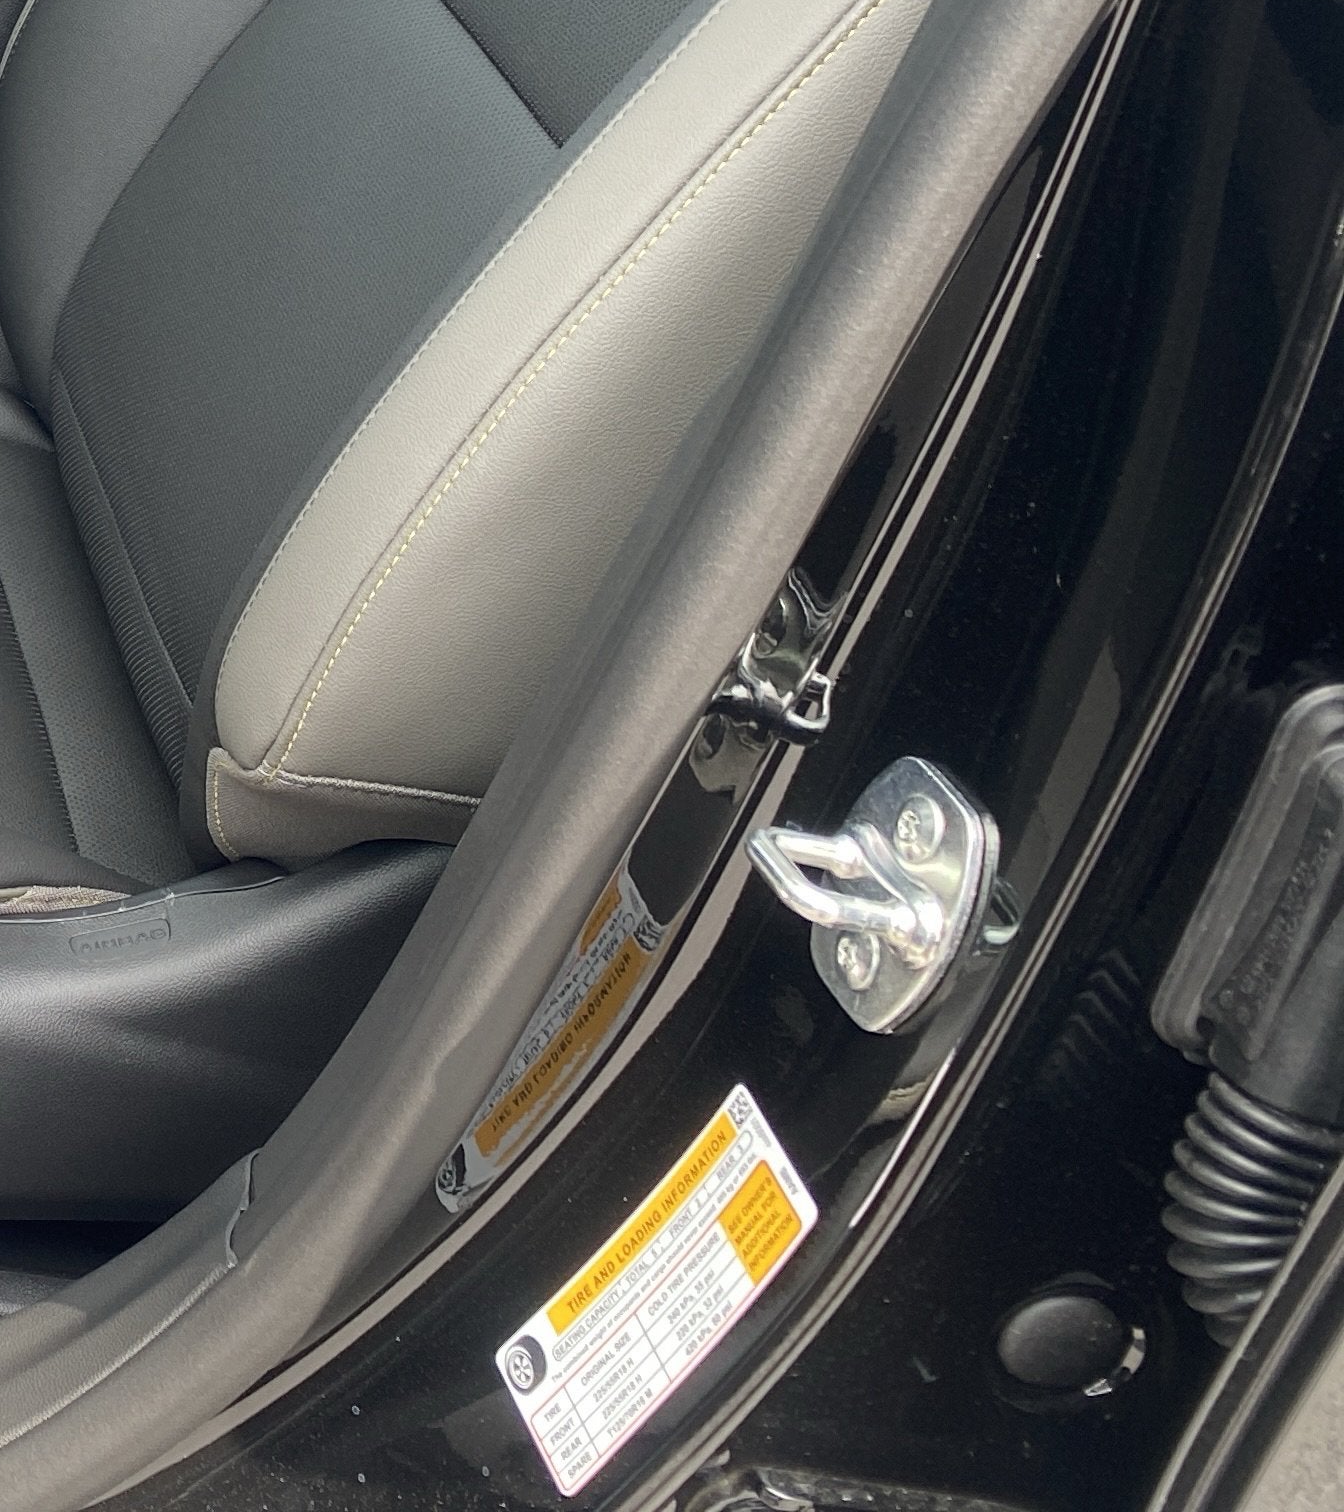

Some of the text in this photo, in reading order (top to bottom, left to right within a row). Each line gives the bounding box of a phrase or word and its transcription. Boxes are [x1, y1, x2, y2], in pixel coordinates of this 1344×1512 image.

[567, 1129, 726, 1314] TIRE AND LOADING INFORMATION
[554, 1324, 585, 1359] SEATING
[584, 1287, 619, 1328] CAPACITY
[625, 1258, 647, 1286] TOTAL
[668, 1206, 692, 1238] FRONT
[715, 1153, 735, 1181] REAR
[648, 1230, 720, 1317] COLD TIRE PRESSURE
[580, 1331, 631, 1387] ORIGINAL SIZE
[543, 1402, 561, 1422] TIRE
[549, 1416, 575, 1446] FRONT
[560, 1435, 582, 1461] REAR
[566, 1450, 592, 1479] SPARE
